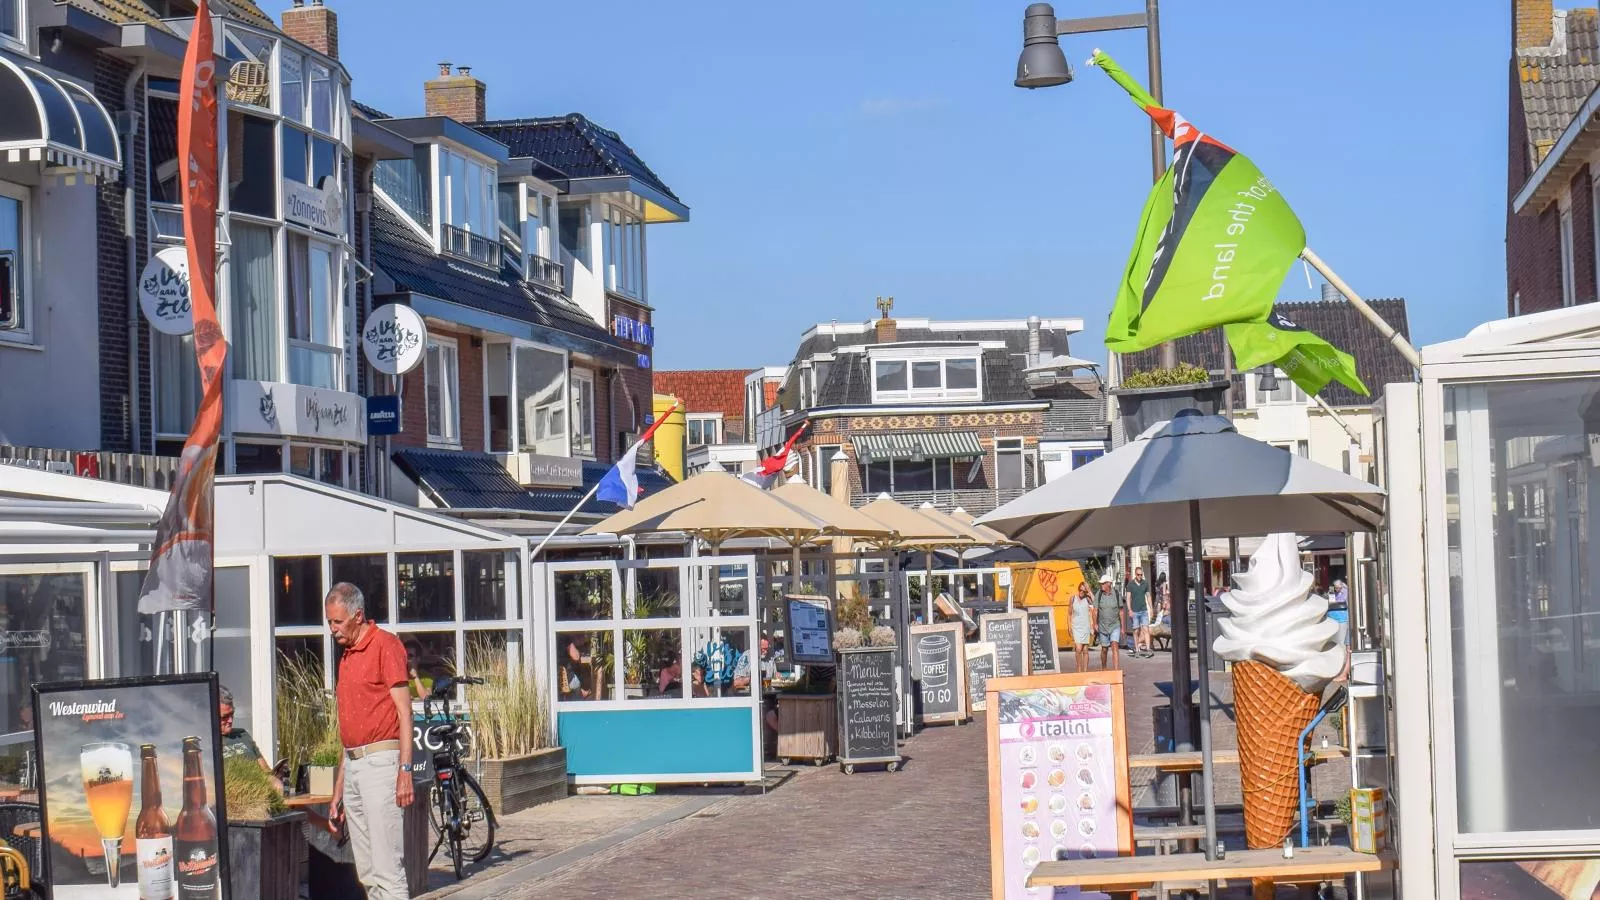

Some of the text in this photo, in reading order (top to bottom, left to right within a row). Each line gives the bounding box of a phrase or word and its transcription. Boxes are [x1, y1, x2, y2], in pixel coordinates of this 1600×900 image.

[292, 194, 327, 226] Zonnevis
[851, 664, 881, 679] Menu
[923, 664, 946, 675] COFFEE
[853, 698, 889, 709] Mosselen
[921, 688, 951, 704] TO GO
[49, 699, 117, 716] Westenwind
[854, 711, 891, 723] Calamaris
[855, 724, 890, 746] Kibbeling
[1039, 719, 1092, 737] italini
[413, 761, 427, 771] us!
